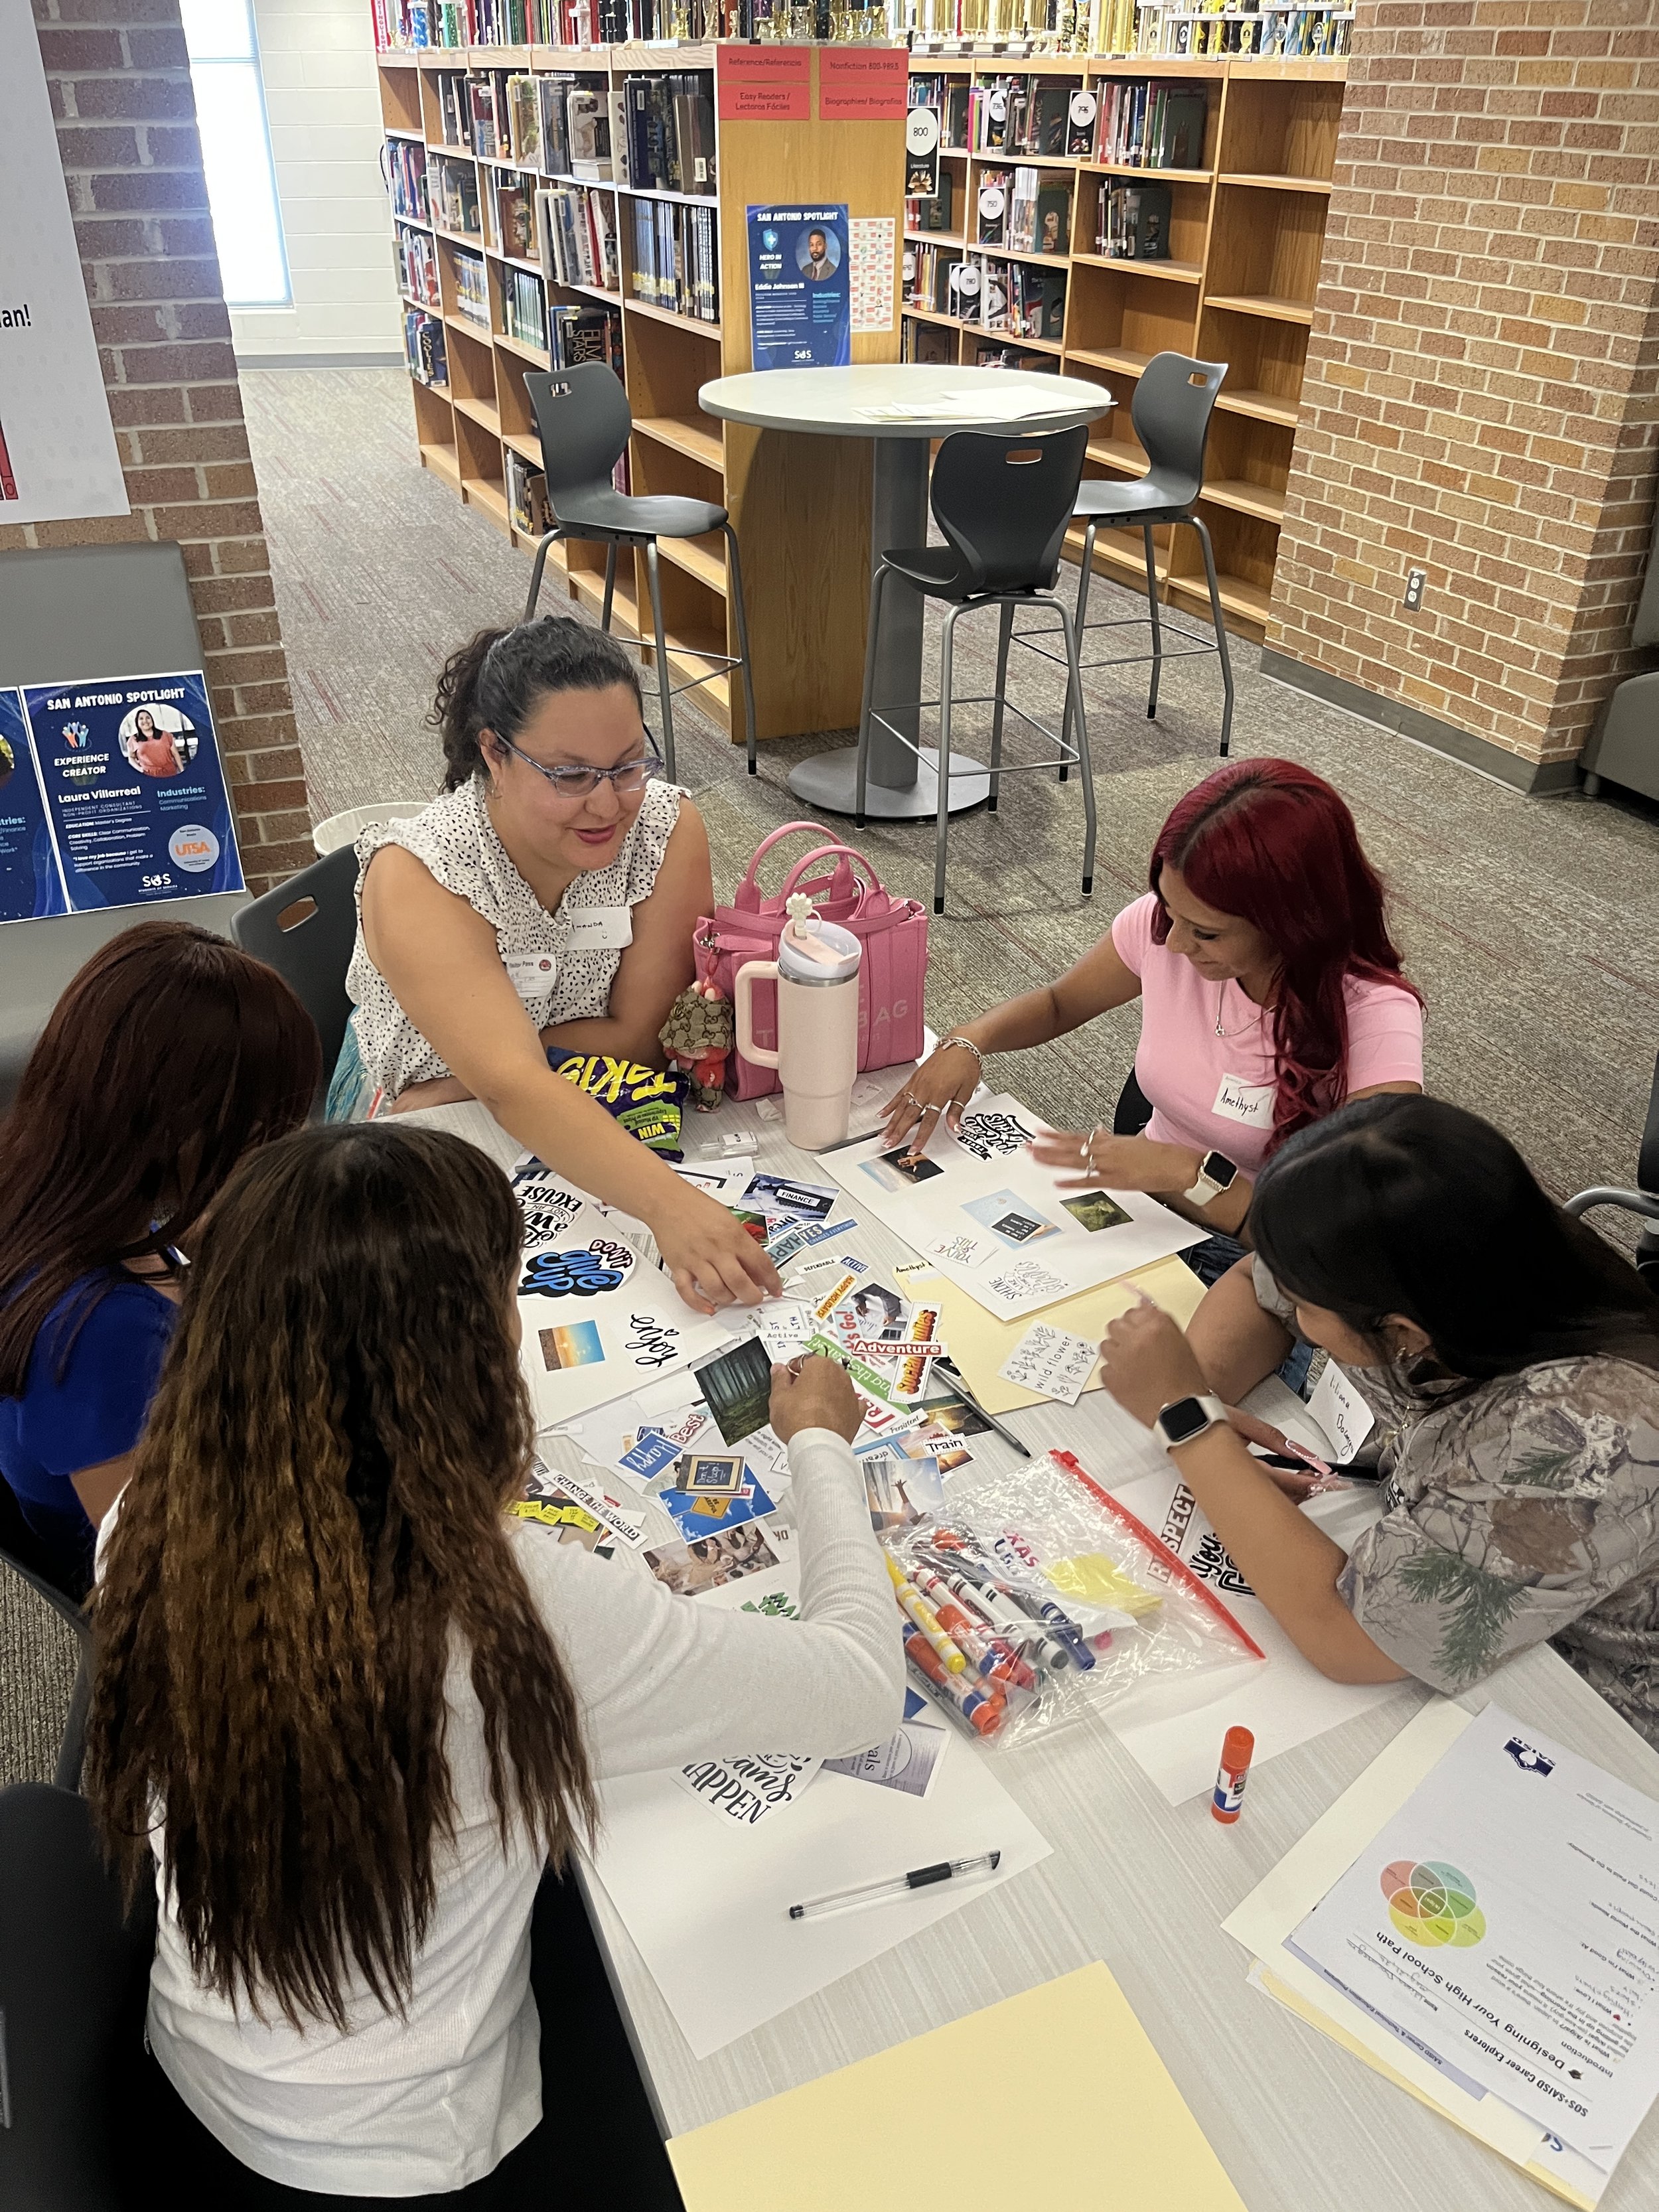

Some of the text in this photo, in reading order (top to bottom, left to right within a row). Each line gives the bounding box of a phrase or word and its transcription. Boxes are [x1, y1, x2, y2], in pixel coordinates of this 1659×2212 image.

[913, 127, 928, 137] 800
[773, 212, 802, 221] ANTONIO
[804, 212, 838, 221] SPOTLIGHT
[0, 304, 31, 328] an!
[573, 330, 586, 362] STARS
[584, 329, 602, 362] FILM
[47, 688, 185, 711] SAN ANTONIO SPOTLIGHT
[54, 753, 109, 767] EXPERIENCE
[62, 766, 106, 778] CREATOR
[58, 786, 141, 804] Laura Villarreal
[157, 786, 206, 797] Industries:
[159, 796, 207, 805] Communications
[175, 841, 211, 856] UTSA
[858, 999, 908, 1028] BAG
[1221, 1088, 1259, 1116] Amethyst
[638, 1123, 665, 1140] WIN
[522, 1185, 583, 1213] EXCUSE
[781, 1191, 814, 1205] FINANCE
[548, 1207, 565, 1218] NOT
[800, 1224, 824, 1240] YES
[952, 1236, 978, 1250] THIS
[589, 1240, 633, 1269] DON'T
[804, 1260, 835, 1272] DEPENDABLE
[843, 1258, 868, 1273] ACTIVE
[896, 1262, 926, 1274] Amethyst
[837, 1275, 855, 1296] HAPPY
[989, 1277, 1022, 1300] SHINE
[835, 1310, 857, 1330] Go!
[913, 1309, 937, 1342] udies
[625, 1314, 678, 1367] enjoy
[855, 1341, 941, 1355] Adventure
[1035, 1336, 1073, 1390] wild flower
[896, 1356, 925, 1394] Socia
[670, 1414, 705, 1445] Best
[890, 1416, 920, 1434] Persistent
[926, 1439, 963, 1452] Train
[626, 1439, 681, 1472] Happy
[554, 1474, 591, 1503] CHANGE
[589, 1497, 609, 1516] THE
[605, 1512, 640, 1540] WORLD
[1148, 1485, 1196, 1584] RSPECT
[1002, 1529, 1040, 1567] XAS
[1590, 1949, 1607, 1960] Good
[1619, 1967, 1634, 1980] What
[1377, 1932, 1565, 2069] Designing Your High School Path
[1596, 2002, 1611, 2014] What
[1404, 2033, 1425, 2051] Career
[1592, 2044, 1609, 2058] What
[1561, 2041, 1613, 2077] Introduction
[1465, 2030, 1588, 2116] SOS+SAISD Career Explorers
